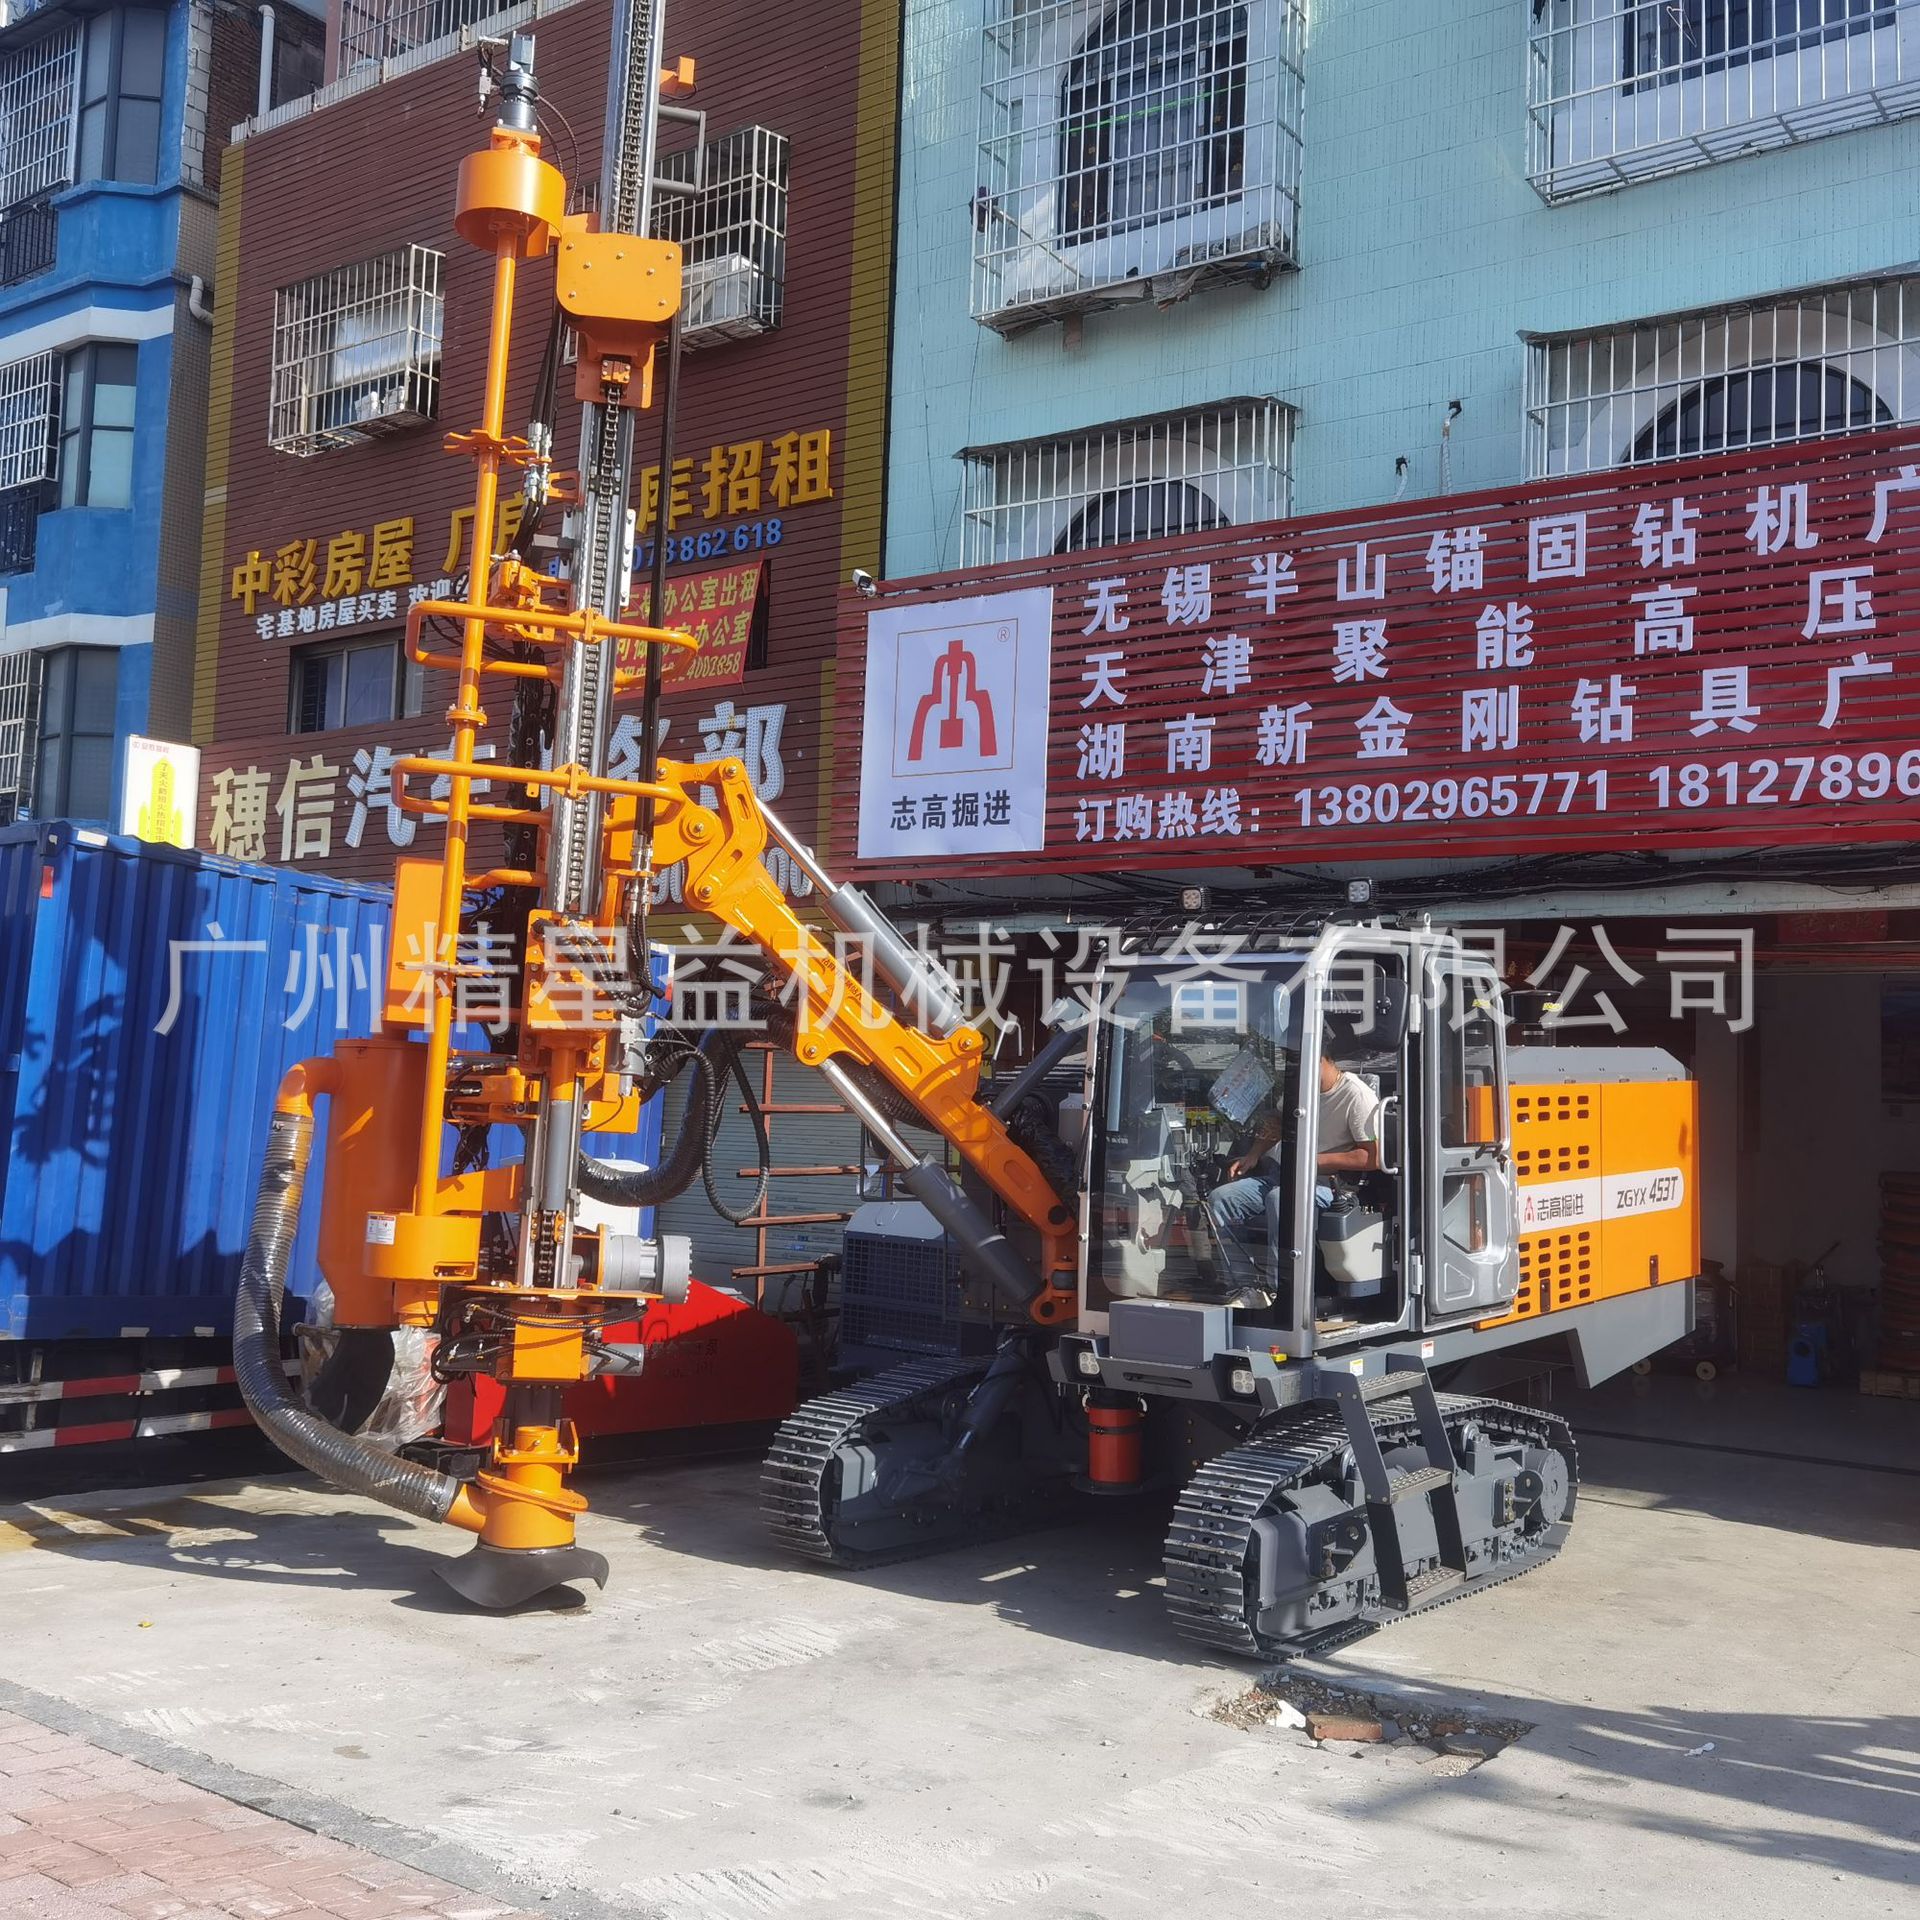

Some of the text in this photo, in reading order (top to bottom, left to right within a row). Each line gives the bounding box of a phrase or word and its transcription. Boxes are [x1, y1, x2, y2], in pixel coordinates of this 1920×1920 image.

[231, 516, 415, 615] 中彩房屋
[255, 590, 398, 640] 宅基地房屋买卖
[1079, 564, 1877, 709] 天津聚能高压
[890, 789, 1011, 831] 志高掘进
[1294, 768, 1608, 828] 13802965771
[1649, 749, 1920, 809] 18127896
[1537, 1175, 1679, 1221] 志高掘进 ZGYX 453T
